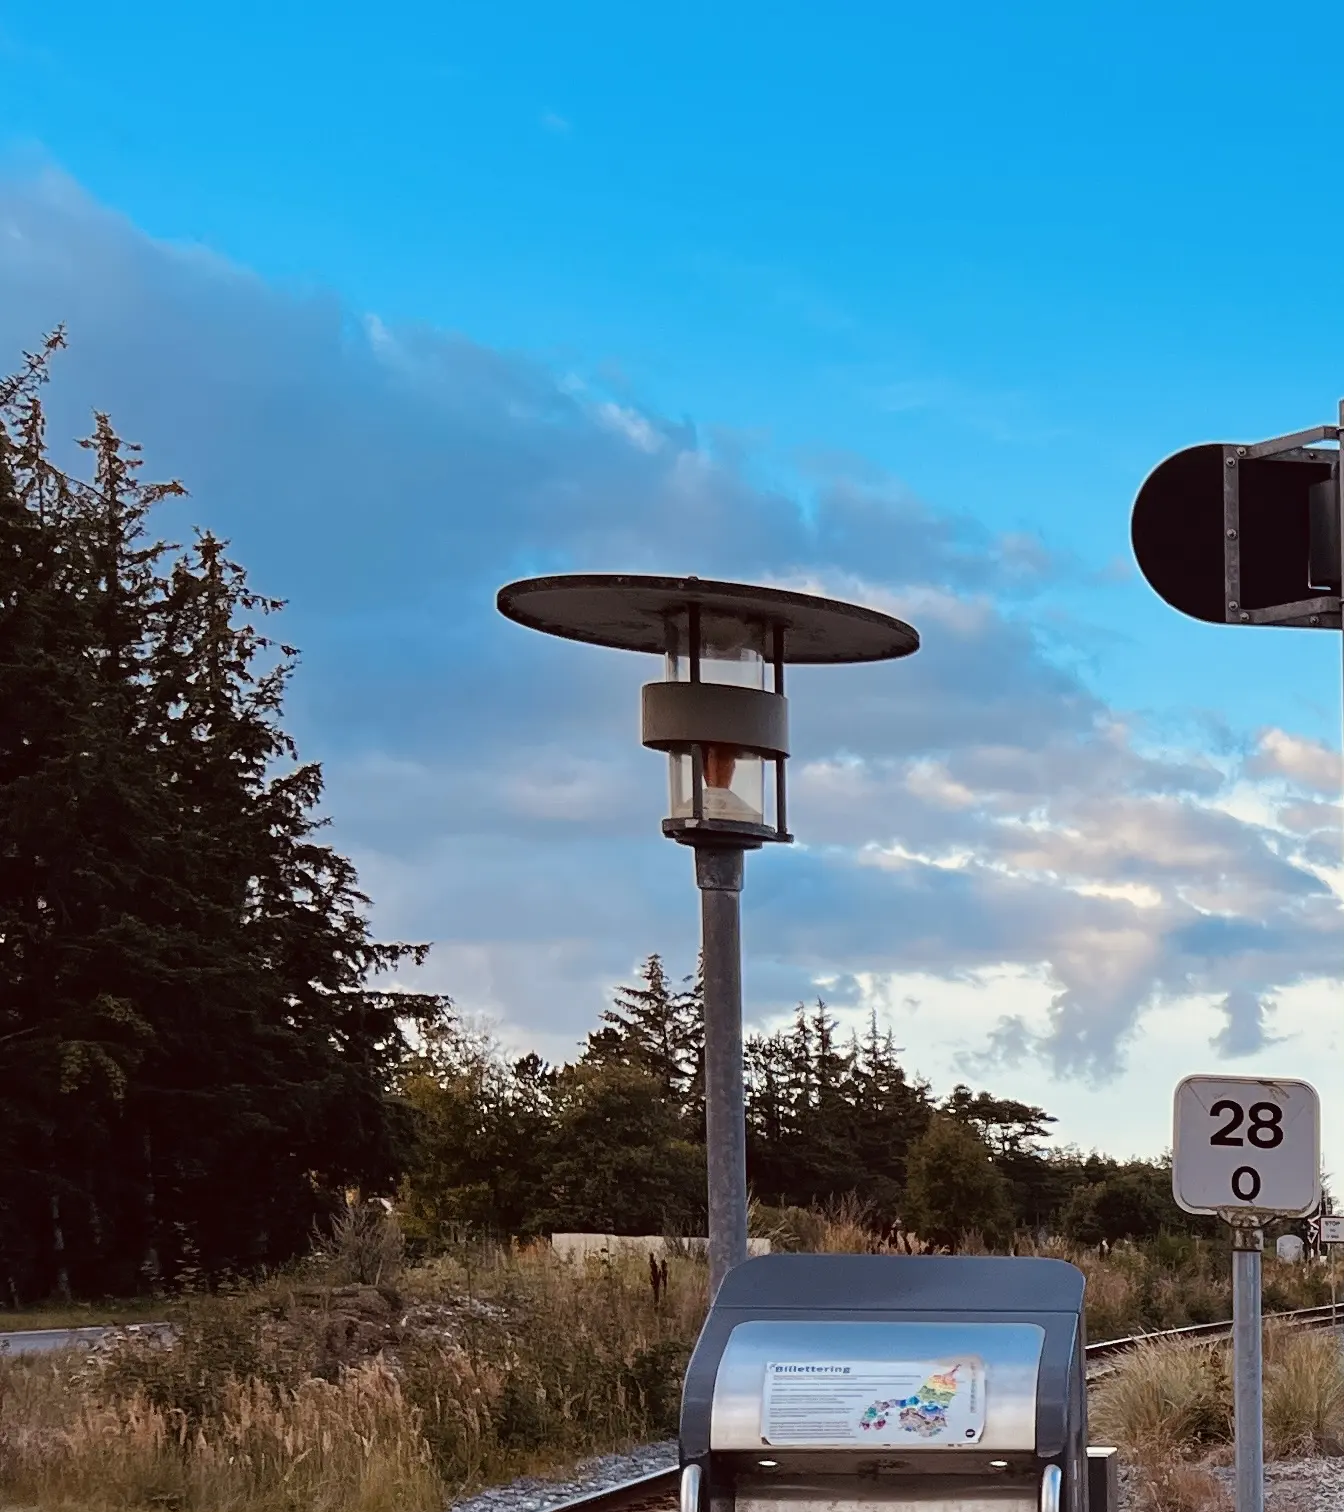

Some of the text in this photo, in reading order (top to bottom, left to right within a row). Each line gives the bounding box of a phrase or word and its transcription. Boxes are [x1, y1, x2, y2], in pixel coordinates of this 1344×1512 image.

[1210, 1100, 1283, 1149] 28
[1231, 1166, 1261, 1201] 0
[775, 1365, 851, 1374] Billettering
